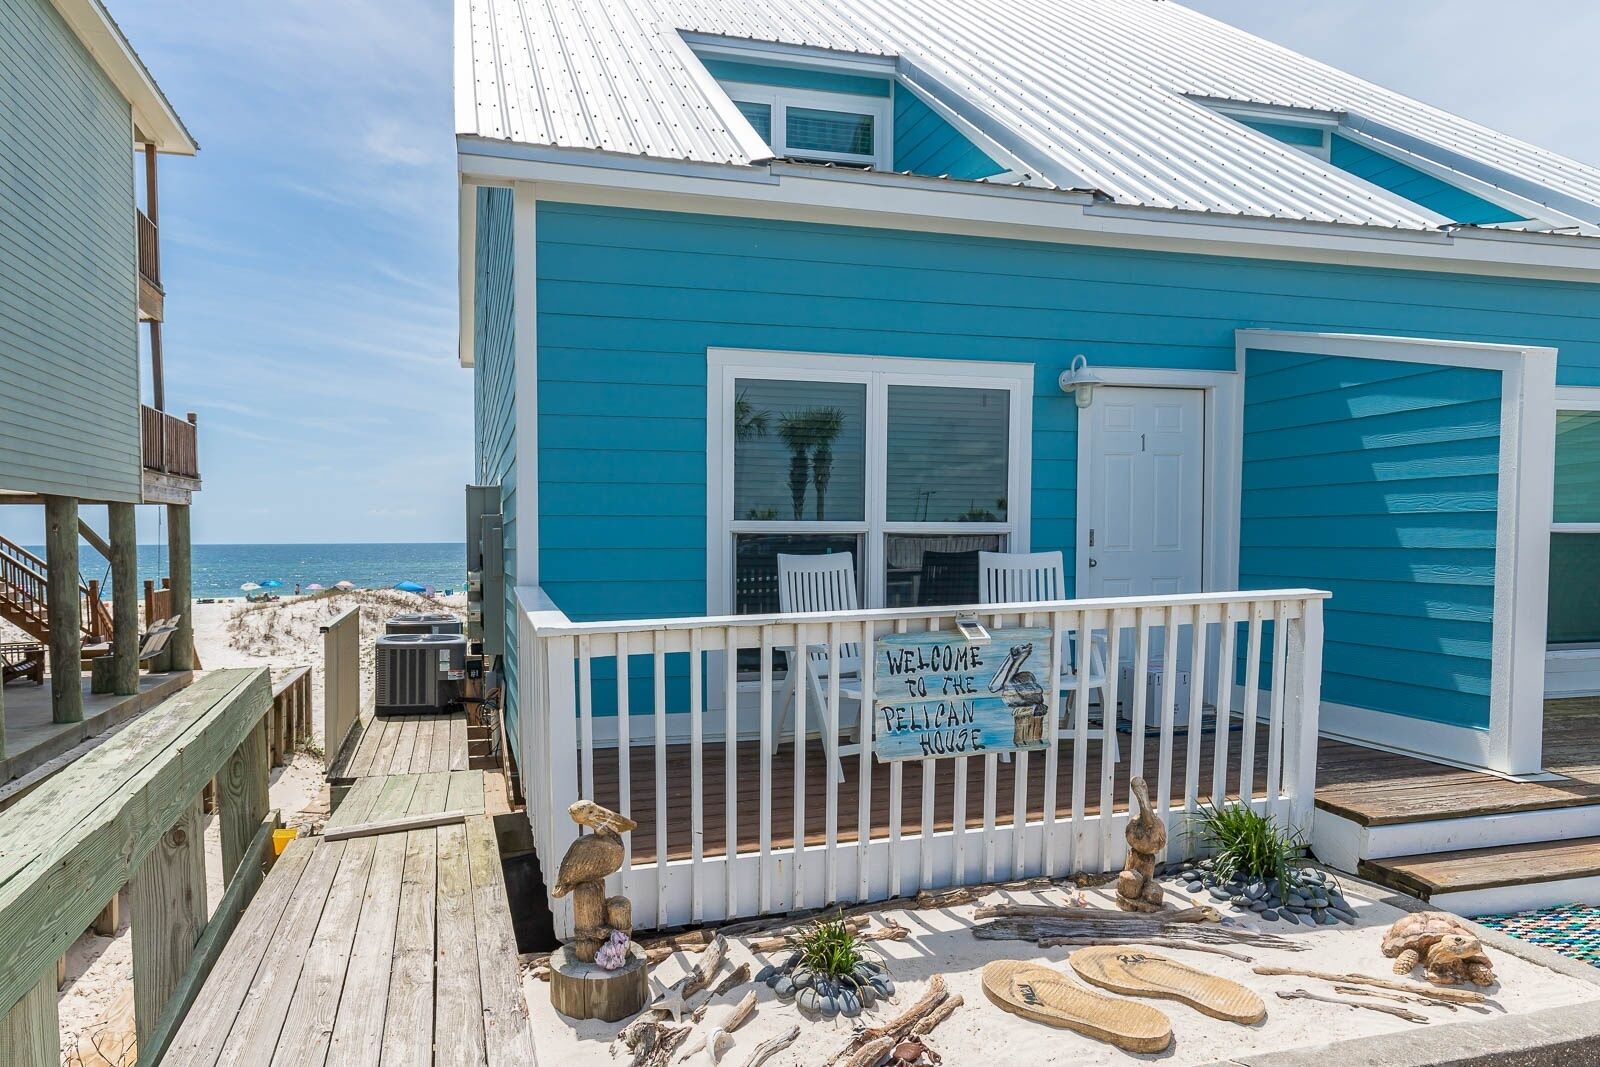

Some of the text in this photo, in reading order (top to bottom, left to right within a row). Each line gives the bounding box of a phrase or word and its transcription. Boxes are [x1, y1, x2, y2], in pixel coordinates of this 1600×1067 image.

[1141, 433, 1146, 452] 1
[887, 645, 983, 675] WELCOME
[904, 676, 977, 697] TO THE
[880, 701, 975, 731] PELICAN
[919, 728, 985, 756] HOUSE
